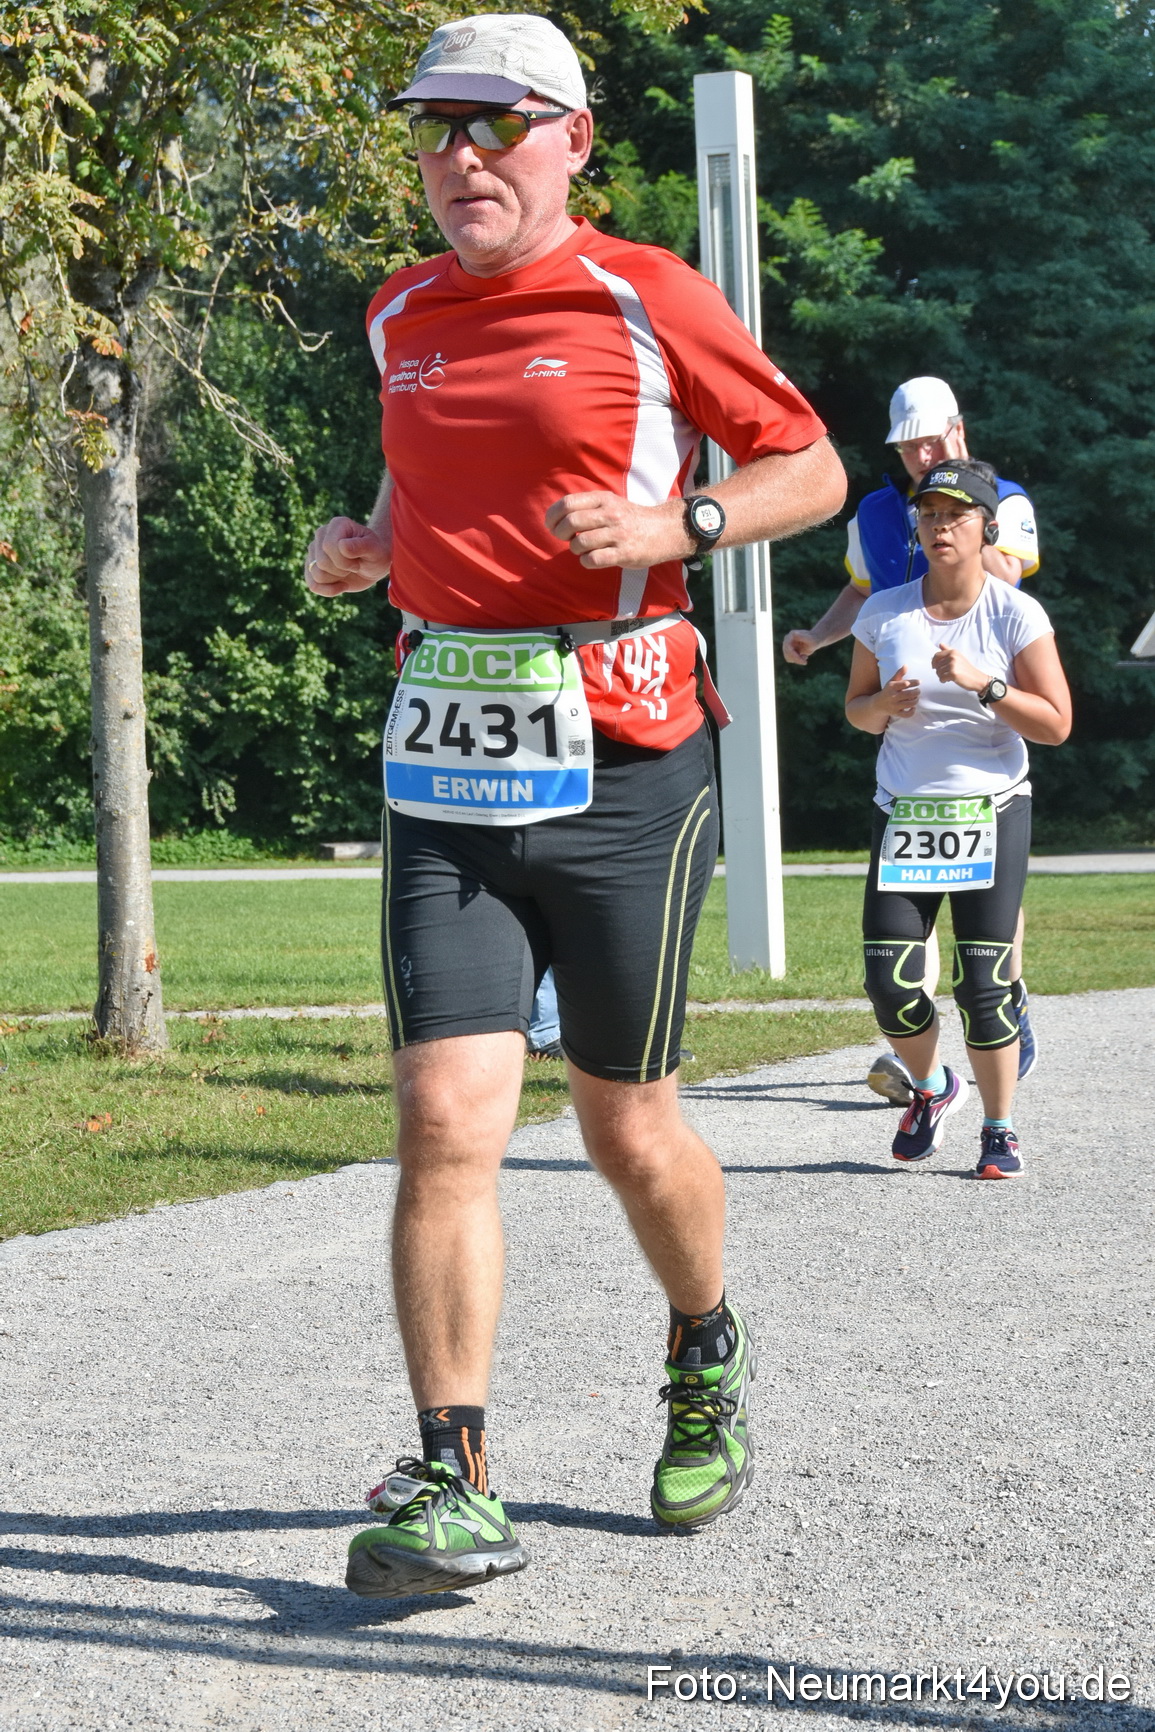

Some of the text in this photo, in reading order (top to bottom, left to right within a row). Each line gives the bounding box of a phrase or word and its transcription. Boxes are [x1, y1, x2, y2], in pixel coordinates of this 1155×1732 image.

[389, 372, 416, 384] Marathon
[413, 640, 559, 687] BOCK
[570, 708, 579, 717] D
[404, 697, 558, 758] 2431
[432, 775, 533, 802] ERWIN
[893, 802, 982, 821] BOCK
[894, 830, 982, 859] 2307
[901, 868, 973, 881] HAI ANH
